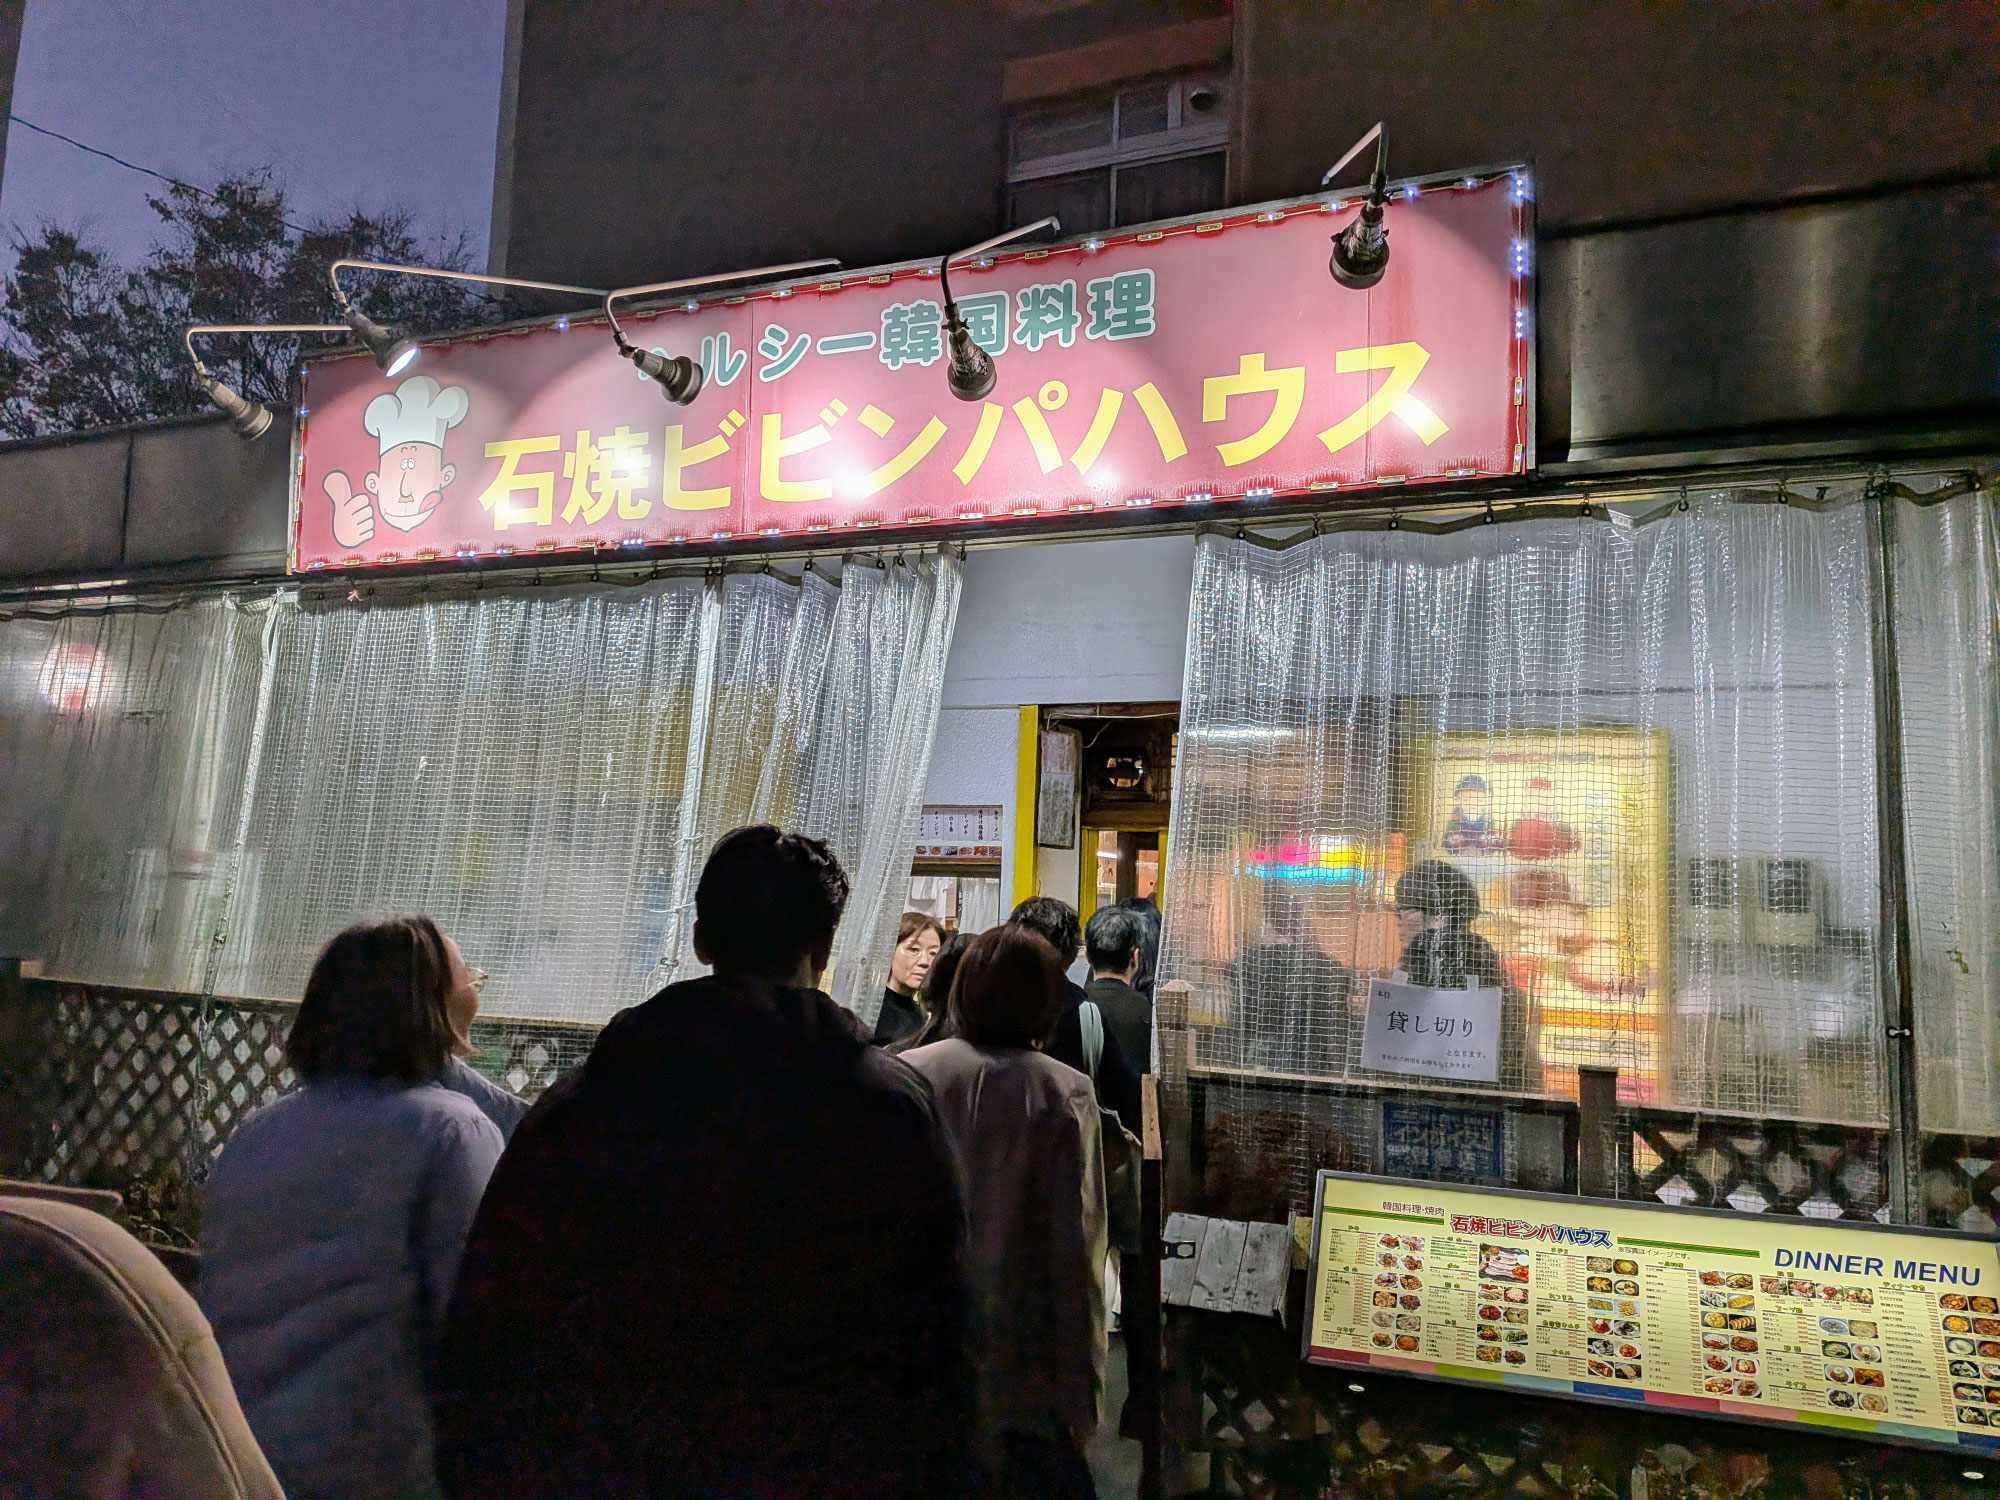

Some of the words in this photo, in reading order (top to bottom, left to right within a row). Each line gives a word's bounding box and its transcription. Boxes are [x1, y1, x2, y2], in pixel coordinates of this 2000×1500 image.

[478, 341, 1450, 532] 石焼ビビンパハウス
[1386, 1010, 1473, 1038] 貸し切り
[1446, 1049, 1487, 1059] となります。
[1450, 1213, 1613, 1249] 石焼ビビンパハウス
[1774, 1248, 1884, 1277] DINNER
[1894, 1260, 1981, 1286] MENU
